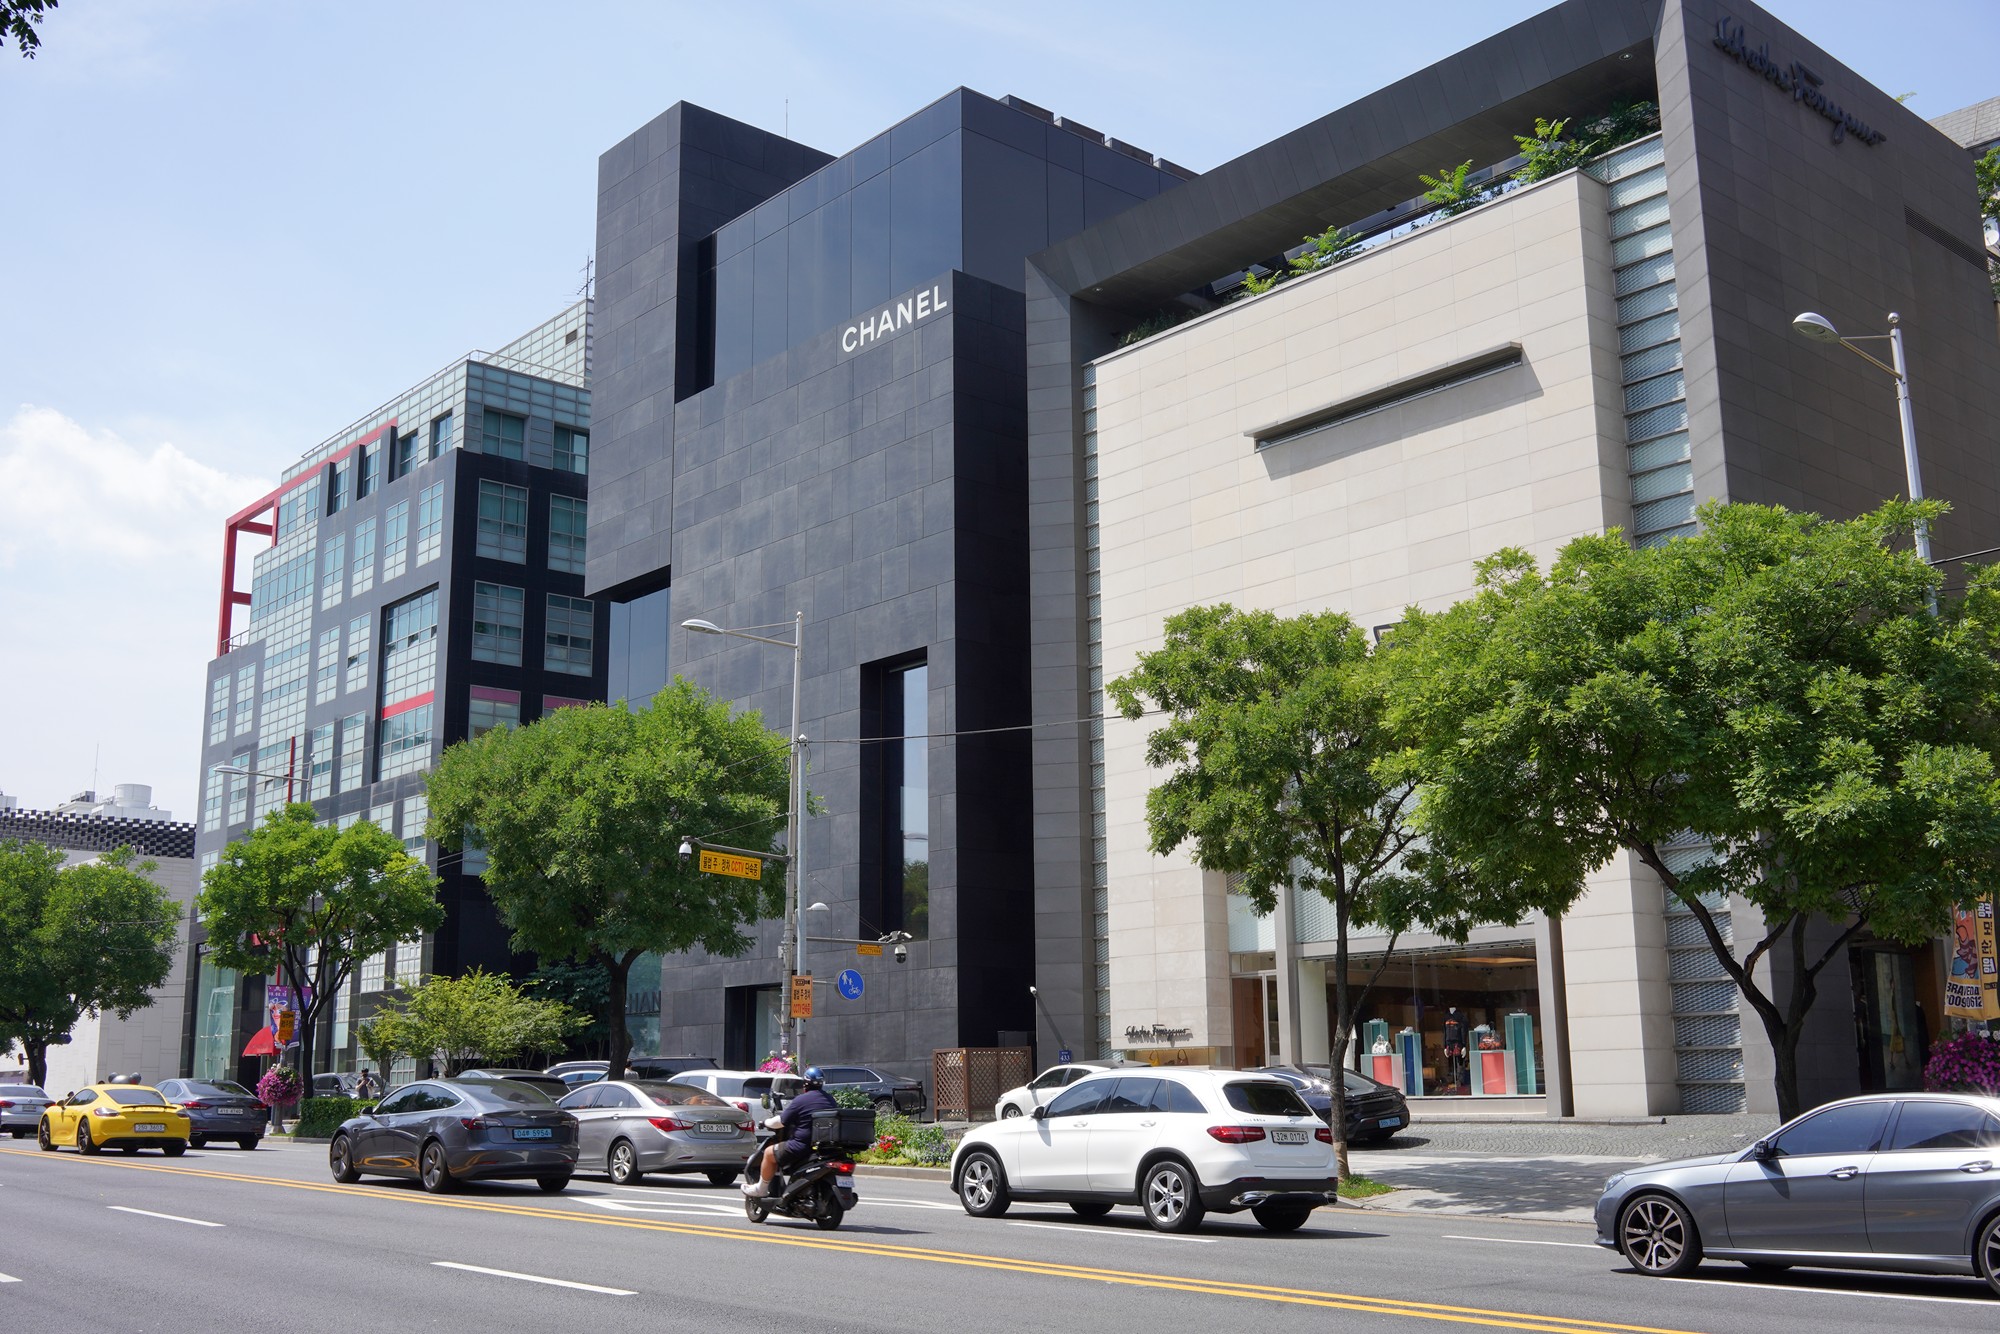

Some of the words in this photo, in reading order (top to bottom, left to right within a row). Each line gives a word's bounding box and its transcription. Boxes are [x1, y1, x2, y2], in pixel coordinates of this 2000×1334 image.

[842, 285, 948, 353] CHANEL
[703, 856, 713, 870] 불법
[731, 861, 745, 873] CCTV
[745, 862, 758, 877] 단속중
[1289, 1133, 1305, 1141] 0174
